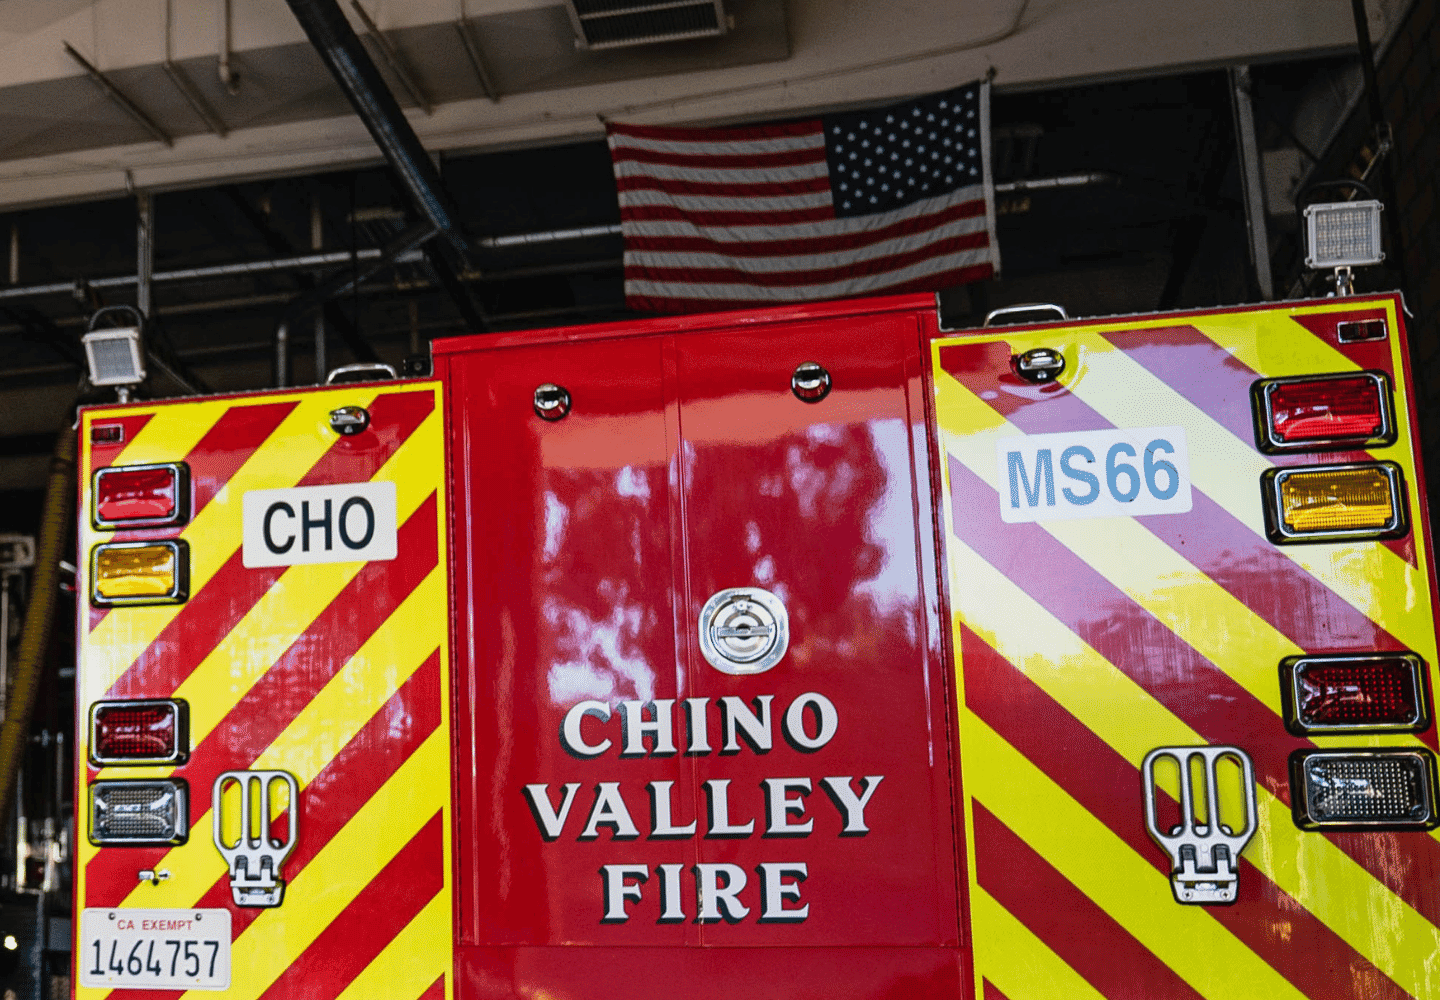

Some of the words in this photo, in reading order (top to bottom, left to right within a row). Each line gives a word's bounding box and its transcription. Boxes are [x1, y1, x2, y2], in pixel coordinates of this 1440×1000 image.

[1007, 438, 1180, 508] MS66
[262, 496, 375, 554] CHO
[560, 692, 839, 759] CHINO
[522, 775, 884, 842] VALLEY
[599, 861, 810, 924] FIRE
[117, 919, 135, 930] CA
[142, 919, 193, 931] EXEMPT
[89, 938, 220, 978] 1464757
